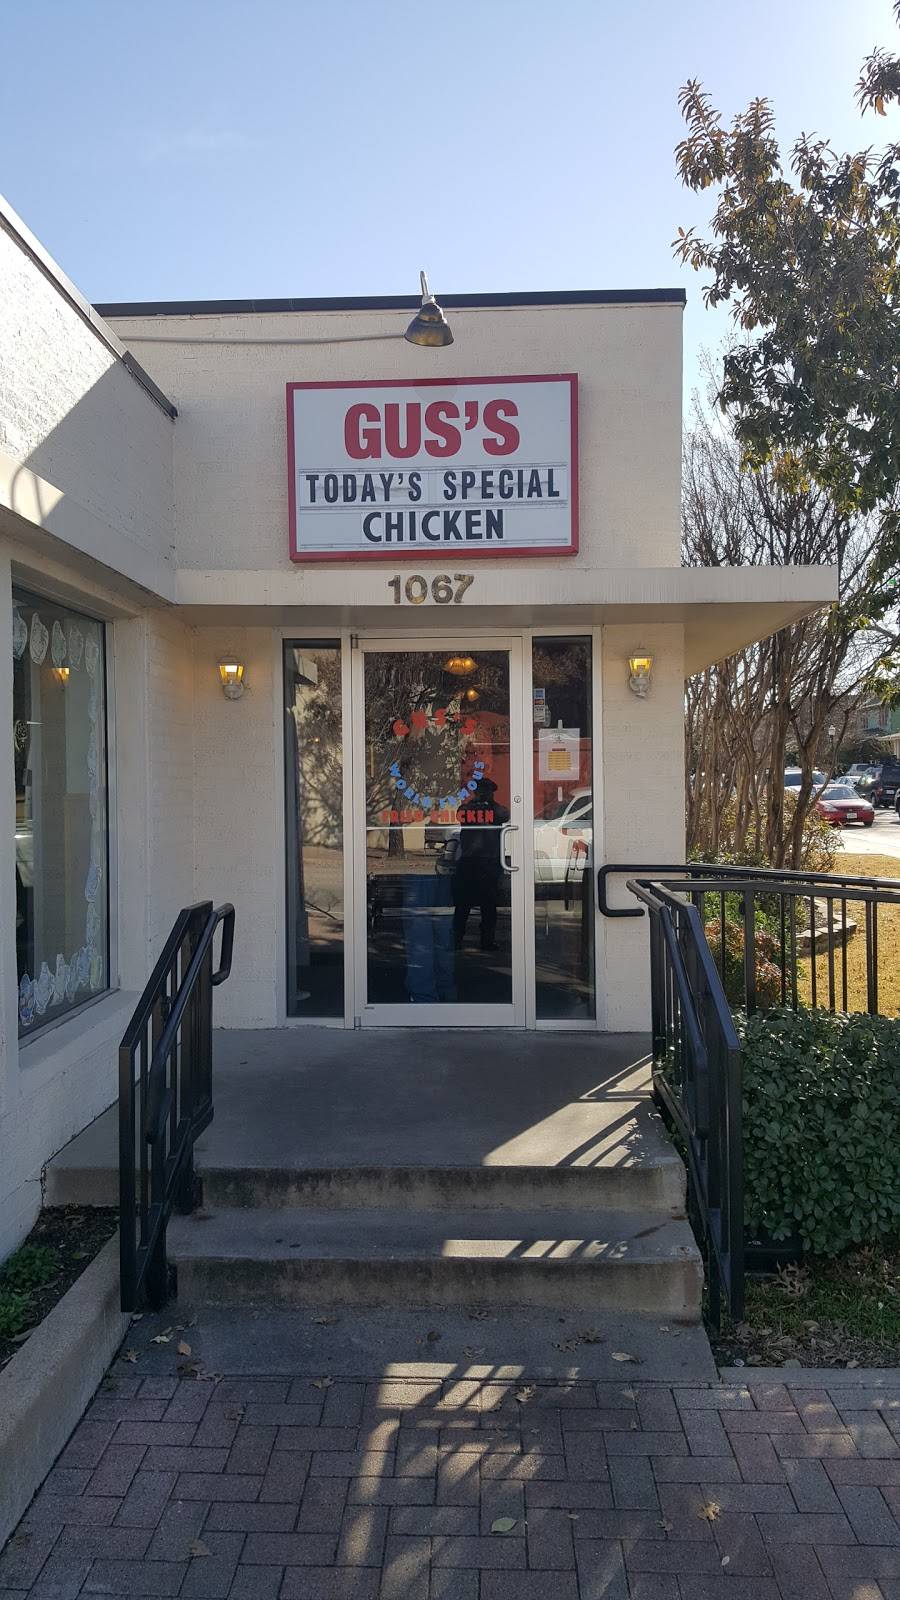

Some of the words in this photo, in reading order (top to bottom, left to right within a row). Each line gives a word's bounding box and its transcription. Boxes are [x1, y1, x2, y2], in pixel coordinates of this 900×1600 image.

[344, 399, 520, 459] GUS'S
[306, 472, 422, 503] TODAY'S
[443, 468, 560, 500] SPECIAL
[362, 509, 504, 542] CHICKEN
[387, 574, 475, 604] 1067
